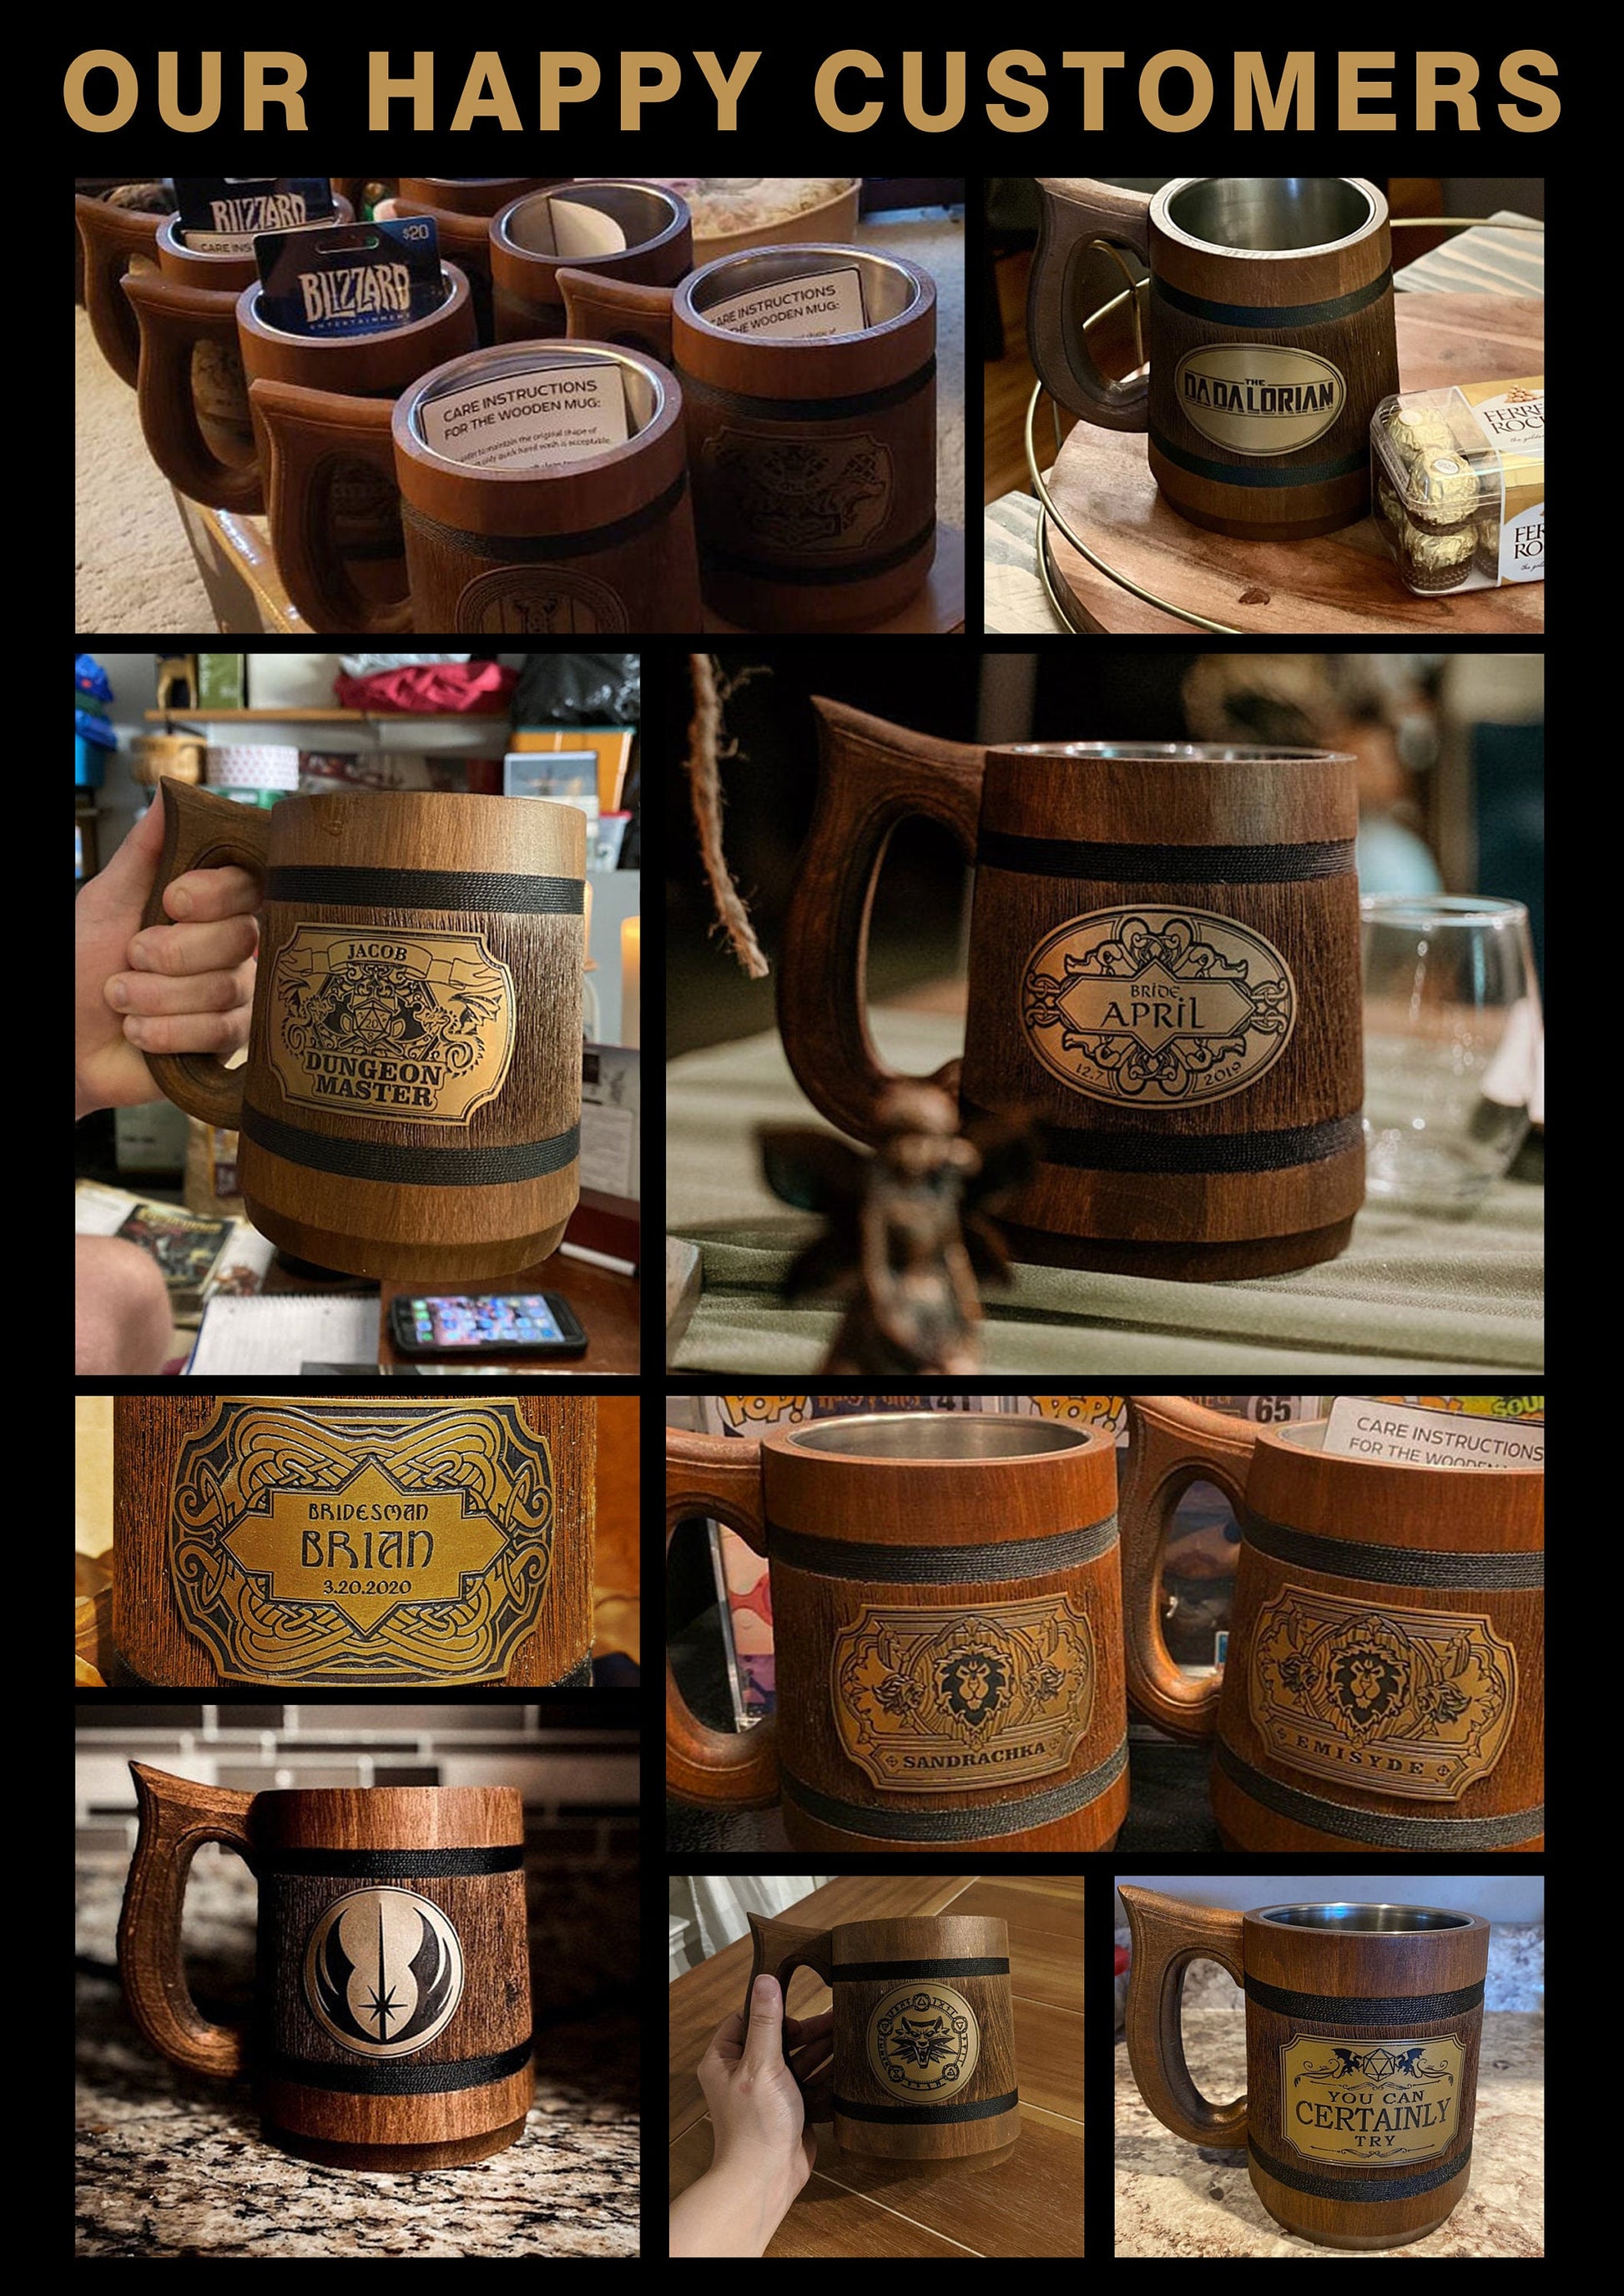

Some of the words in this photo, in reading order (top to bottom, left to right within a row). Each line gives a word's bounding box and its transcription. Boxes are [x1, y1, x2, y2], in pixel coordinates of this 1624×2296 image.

[402, 224, 429, 240] $20
[298, 263, 411, 323] BLIZZARD
[711, 311, 736, 326] ARE
[738, 285, 836, 319] INSTRUCTIONS
[310, 313, 411, 330] ENTERTAINMENT
[750, 307, 804, 329] WOODEN
[806, 301, 840, 315] MUG:
[443, 400, 481, 422] CARE
[482, 380, 598, 409] INSTRUCTIONS
[1184, 372, 1334, 415] DADALORIAN
[444, 424, 469, 440] FOR
[471, 413, 496, 430] THE
[498, 401, 562, 420] WOODEN
[564, 398, 601, 410] MUG:
[1515, 541, 1543, 559] RO
[347, 944, 407, 960] JACOB
[366, 1020, 379, 1029] 20
[306, 1051, 441, 1085] DUNGEON
[1074, 1063, 1105, 1082] 12.7
[1204, 1061, 1242, 1085] 2019
[316, 1075, 433, 1106] MASTER
[723, 1396, 807, 1427] POP!
[1030, 1396, 1125, 1432] POP!
[1256, 1396, 1292, 1423] 65
[1349, 1438, 1383, 1454] FOR
[1388, 1444, 1420, 1463] THE
[1426, 1452, 1498, 1468] WOOD
[1357, 1417, 1409, 1438] CARE
[1412, 1427, 1544, 1461] INSTRUCTIONS
[310, 1503, 429, 1522] BRIDESMAN
[301, 1530, 433, 1569] BRIAN
[323, 1580, 412, 1595] 3.20.2020
[904, 1742, 1046, 1768] SANDRACHKA
[1296, 1735, 1424, 1775] EMISYDE
[1328, 2091, 1373, 2104] YOU
[1383, 2090, 1425, 2103] CAN
[1295, 2097, 1451, 2132] CERTAINLY
[1355, 2135, 1395, 2147] TRY
